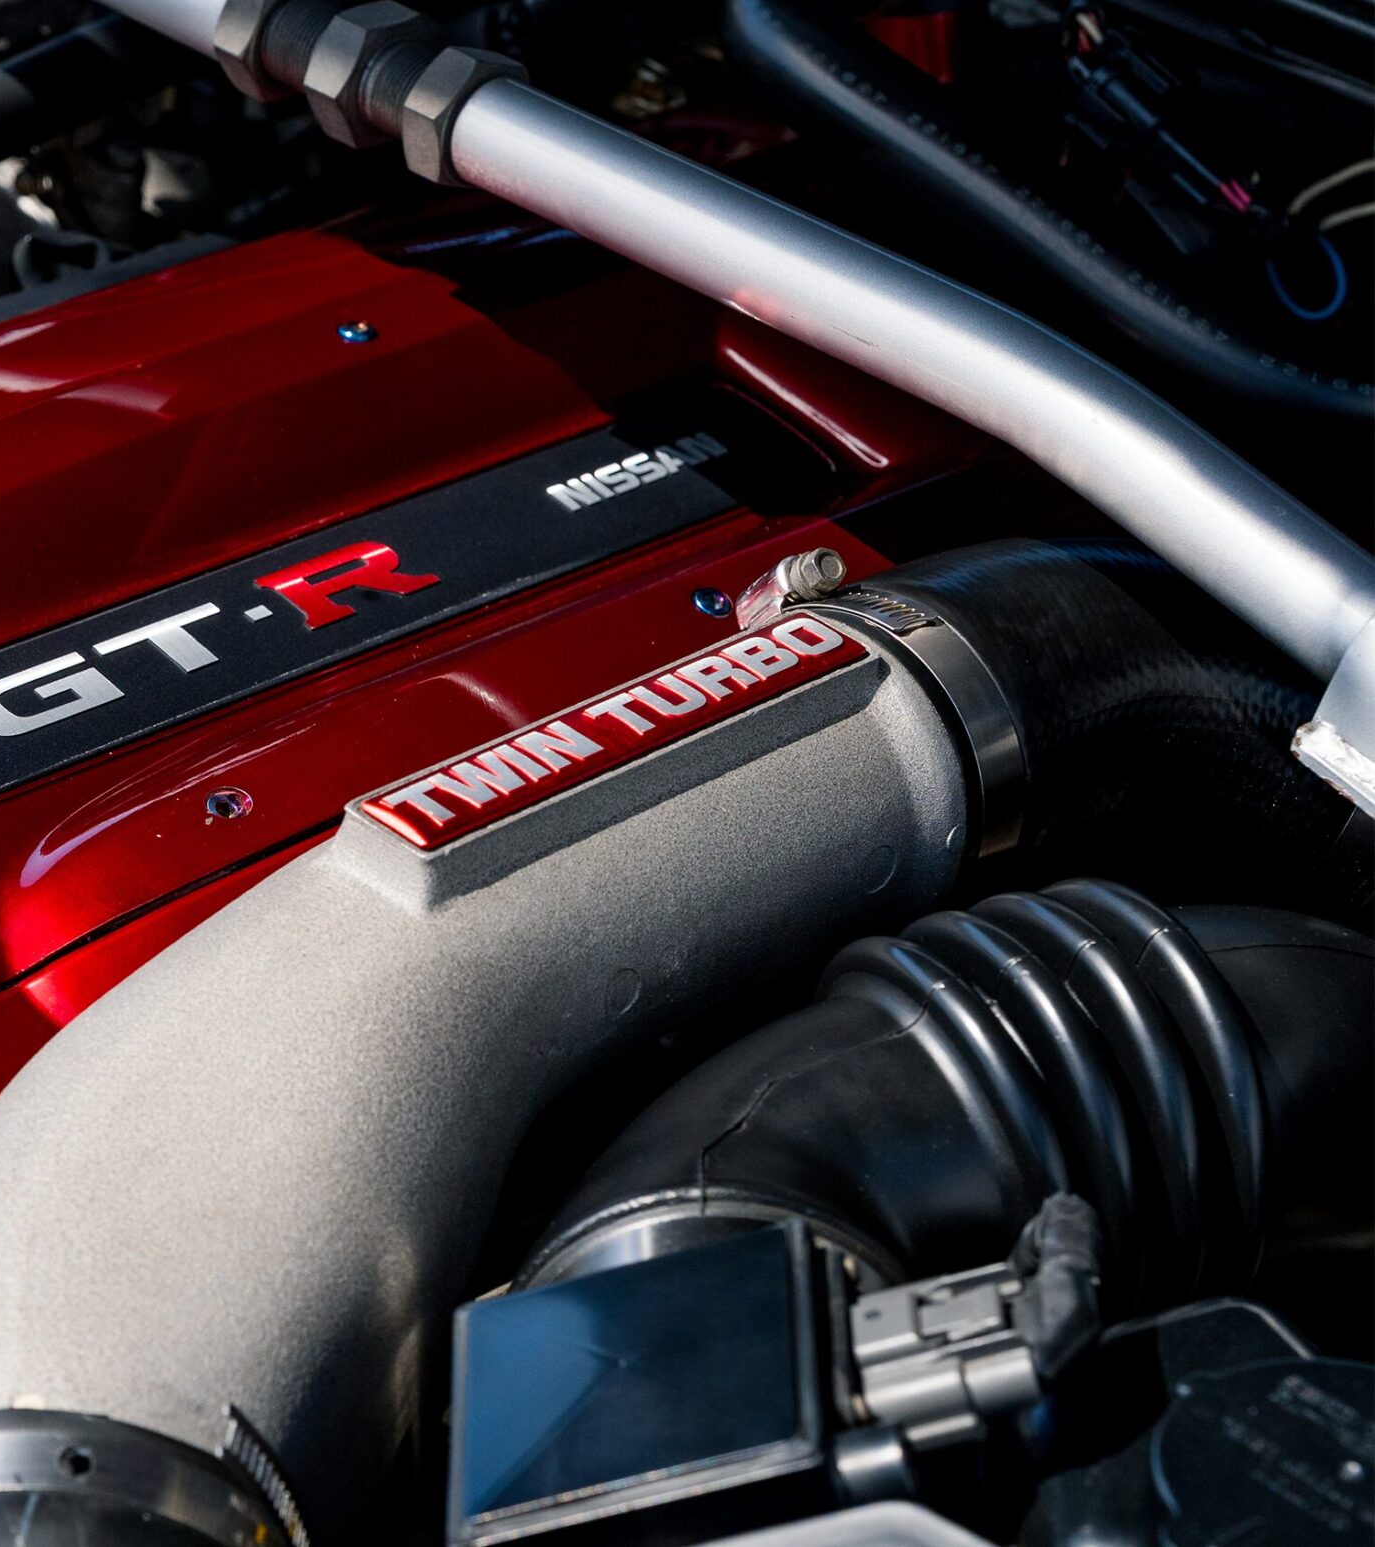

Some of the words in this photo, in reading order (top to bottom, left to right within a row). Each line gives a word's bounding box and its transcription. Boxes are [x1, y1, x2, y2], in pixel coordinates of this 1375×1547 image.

[545, 431, 729, 512] NISSAN
[381, 720, 605, 828] TWIN
[582, 616, 845, 738] TURBO
